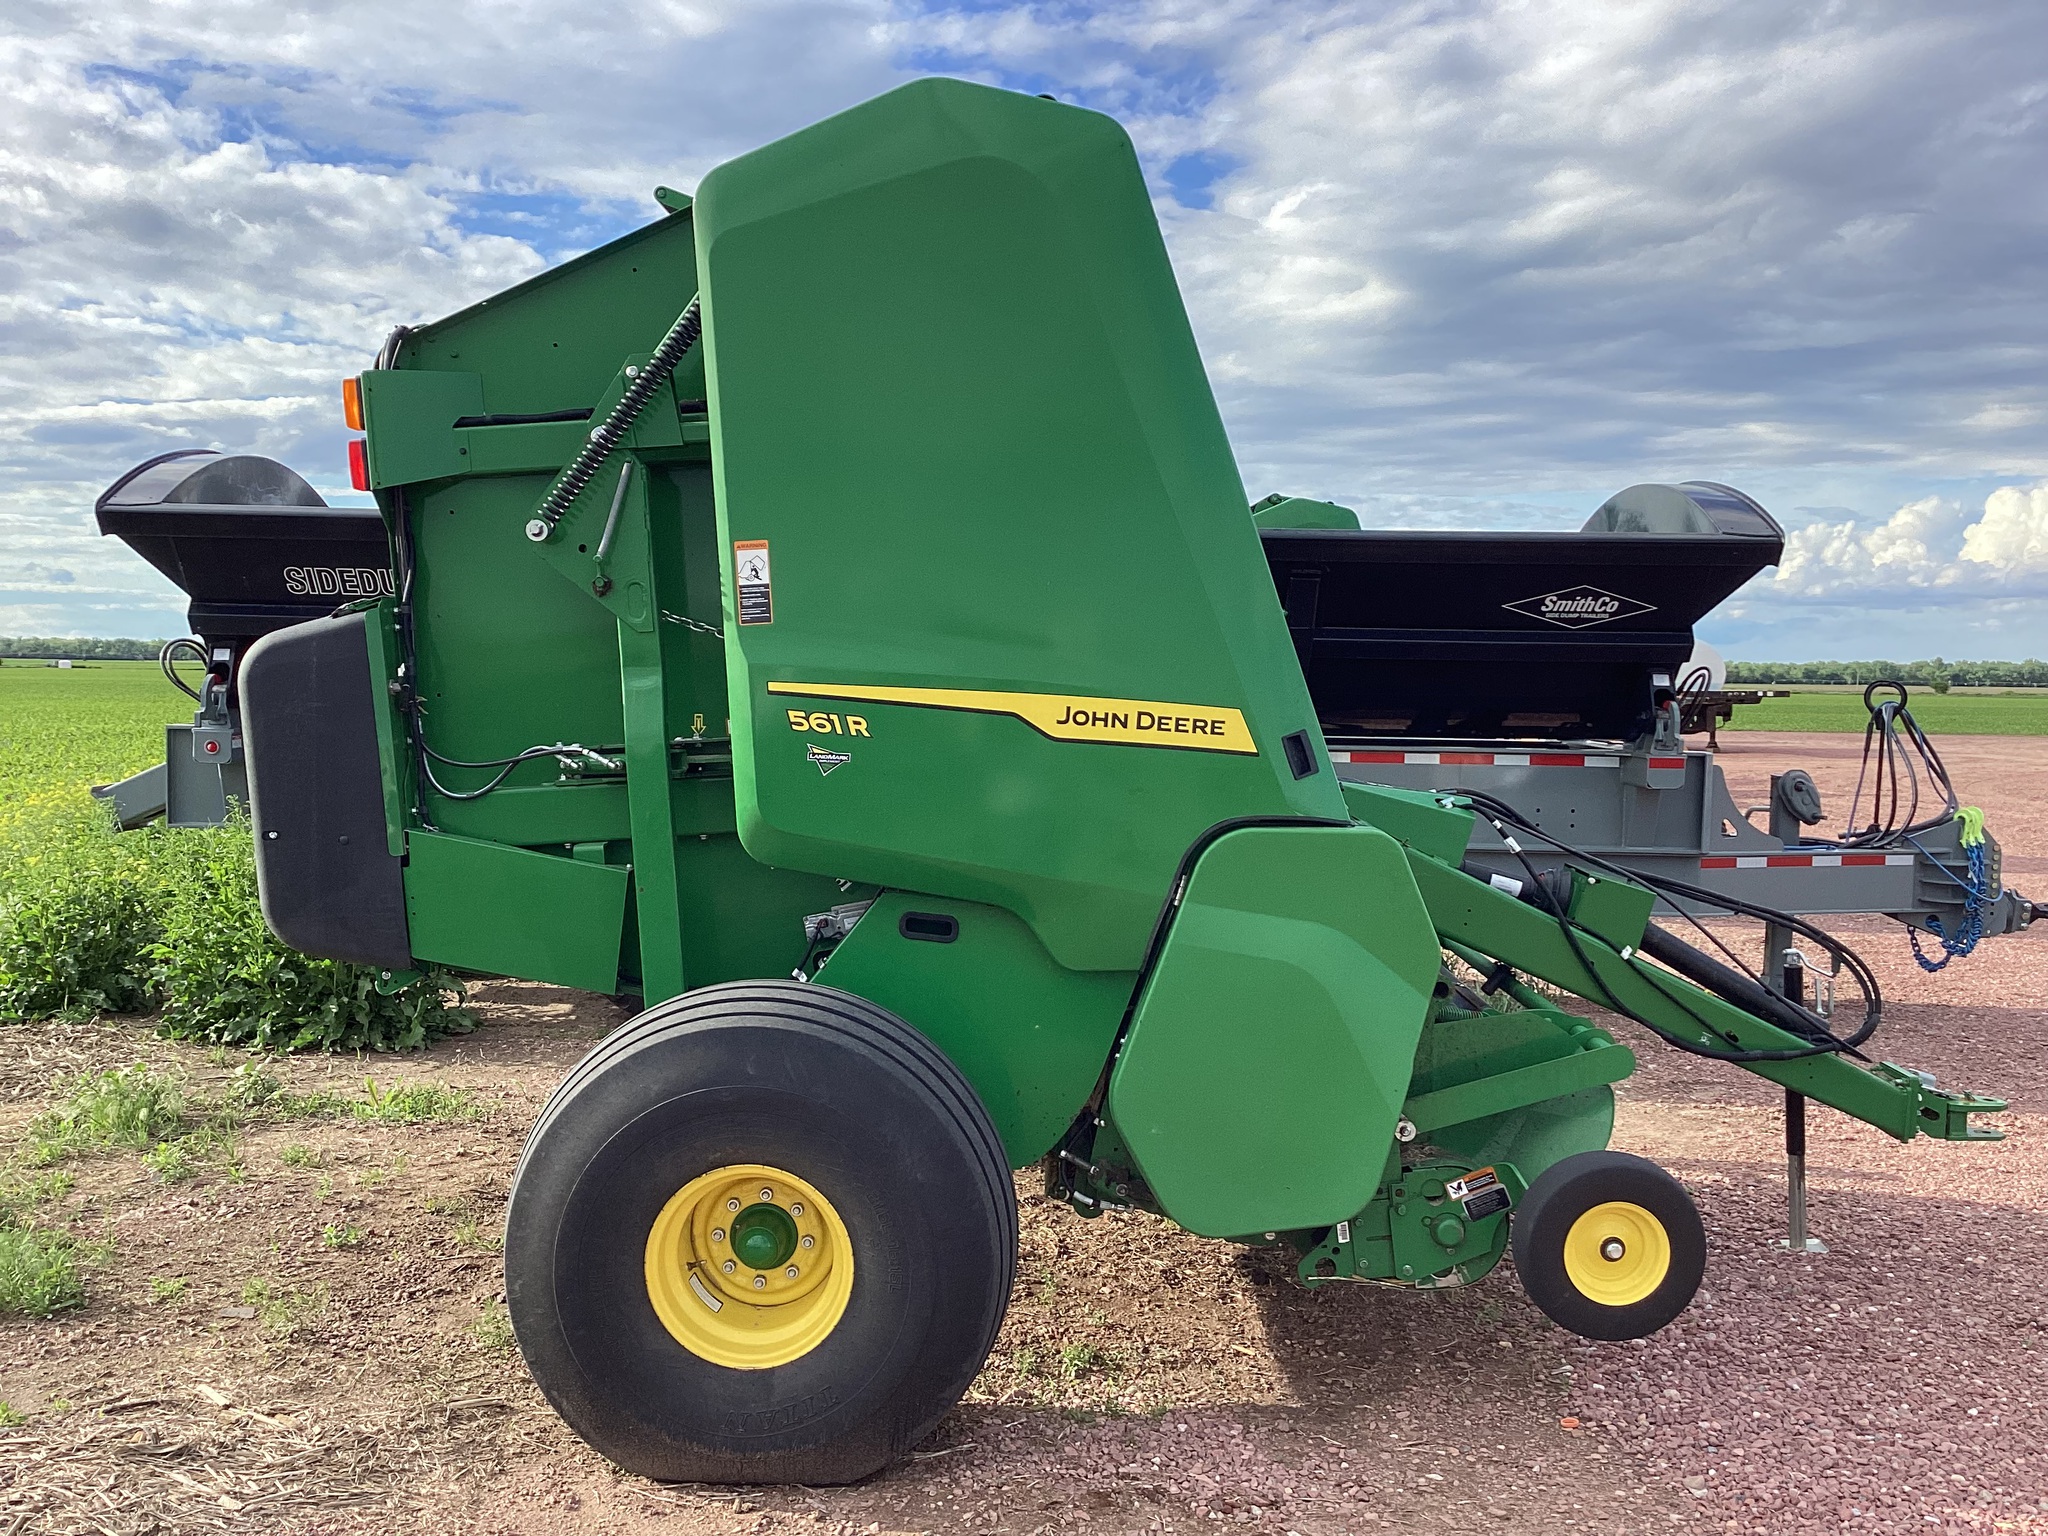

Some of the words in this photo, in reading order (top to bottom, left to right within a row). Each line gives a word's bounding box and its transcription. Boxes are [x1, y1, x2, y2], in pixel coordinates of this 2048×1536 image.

[740, 541, 767, 549] WARNING
[1540, 596, 1619, 613] SmithCo
[1056, 705, 1129, 729] JOHN
[1135, 711, 1226, 736] DEERE
[720, 1385, 841, 1433] TITAN
